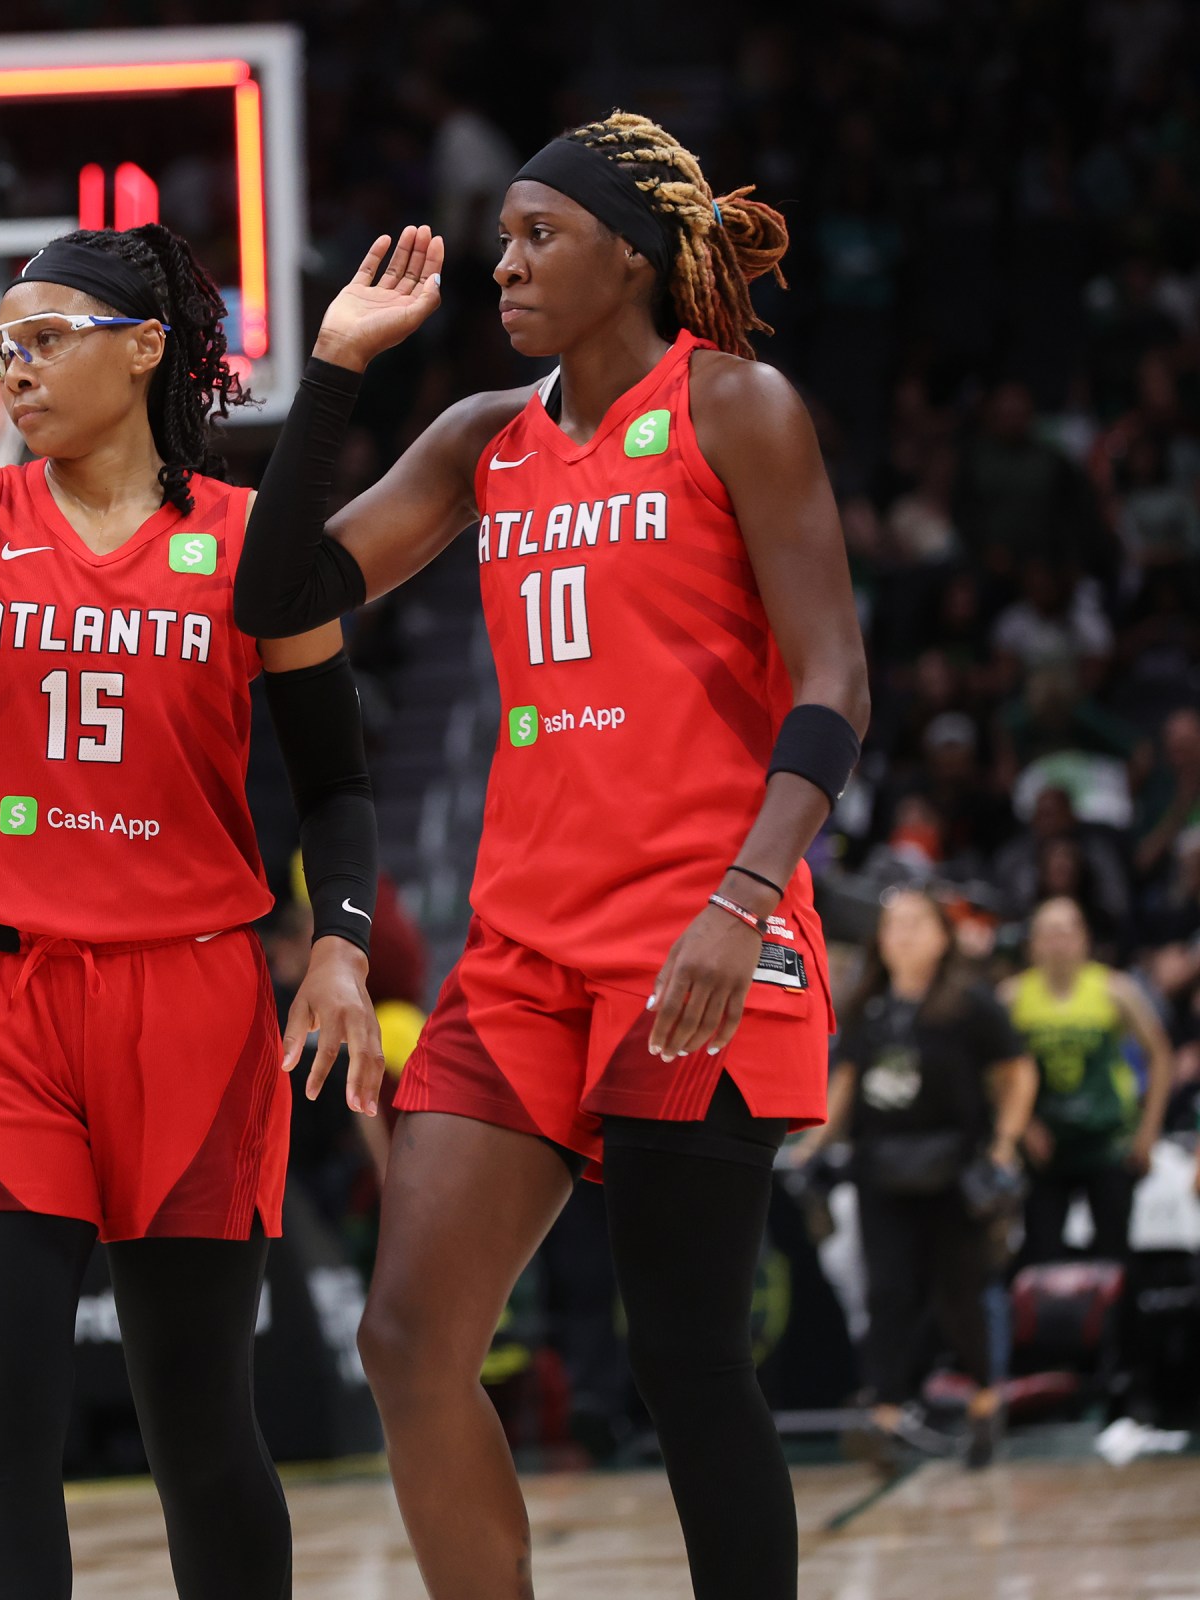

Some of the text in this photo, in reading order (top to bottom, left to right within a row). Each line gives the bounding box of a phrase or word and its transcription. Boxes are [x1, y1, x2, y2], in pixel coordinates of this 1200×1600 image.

[478, 490, 667, 564] ATLANTA
[519, 564, 592, 666] 10
[40, 668, 124, 764] 15
[541, 709, 575, 734] ash
[578, 705, 626, 731] App
[46, 807, 105, 832] Cash
[108, 813, 161, 841] App
